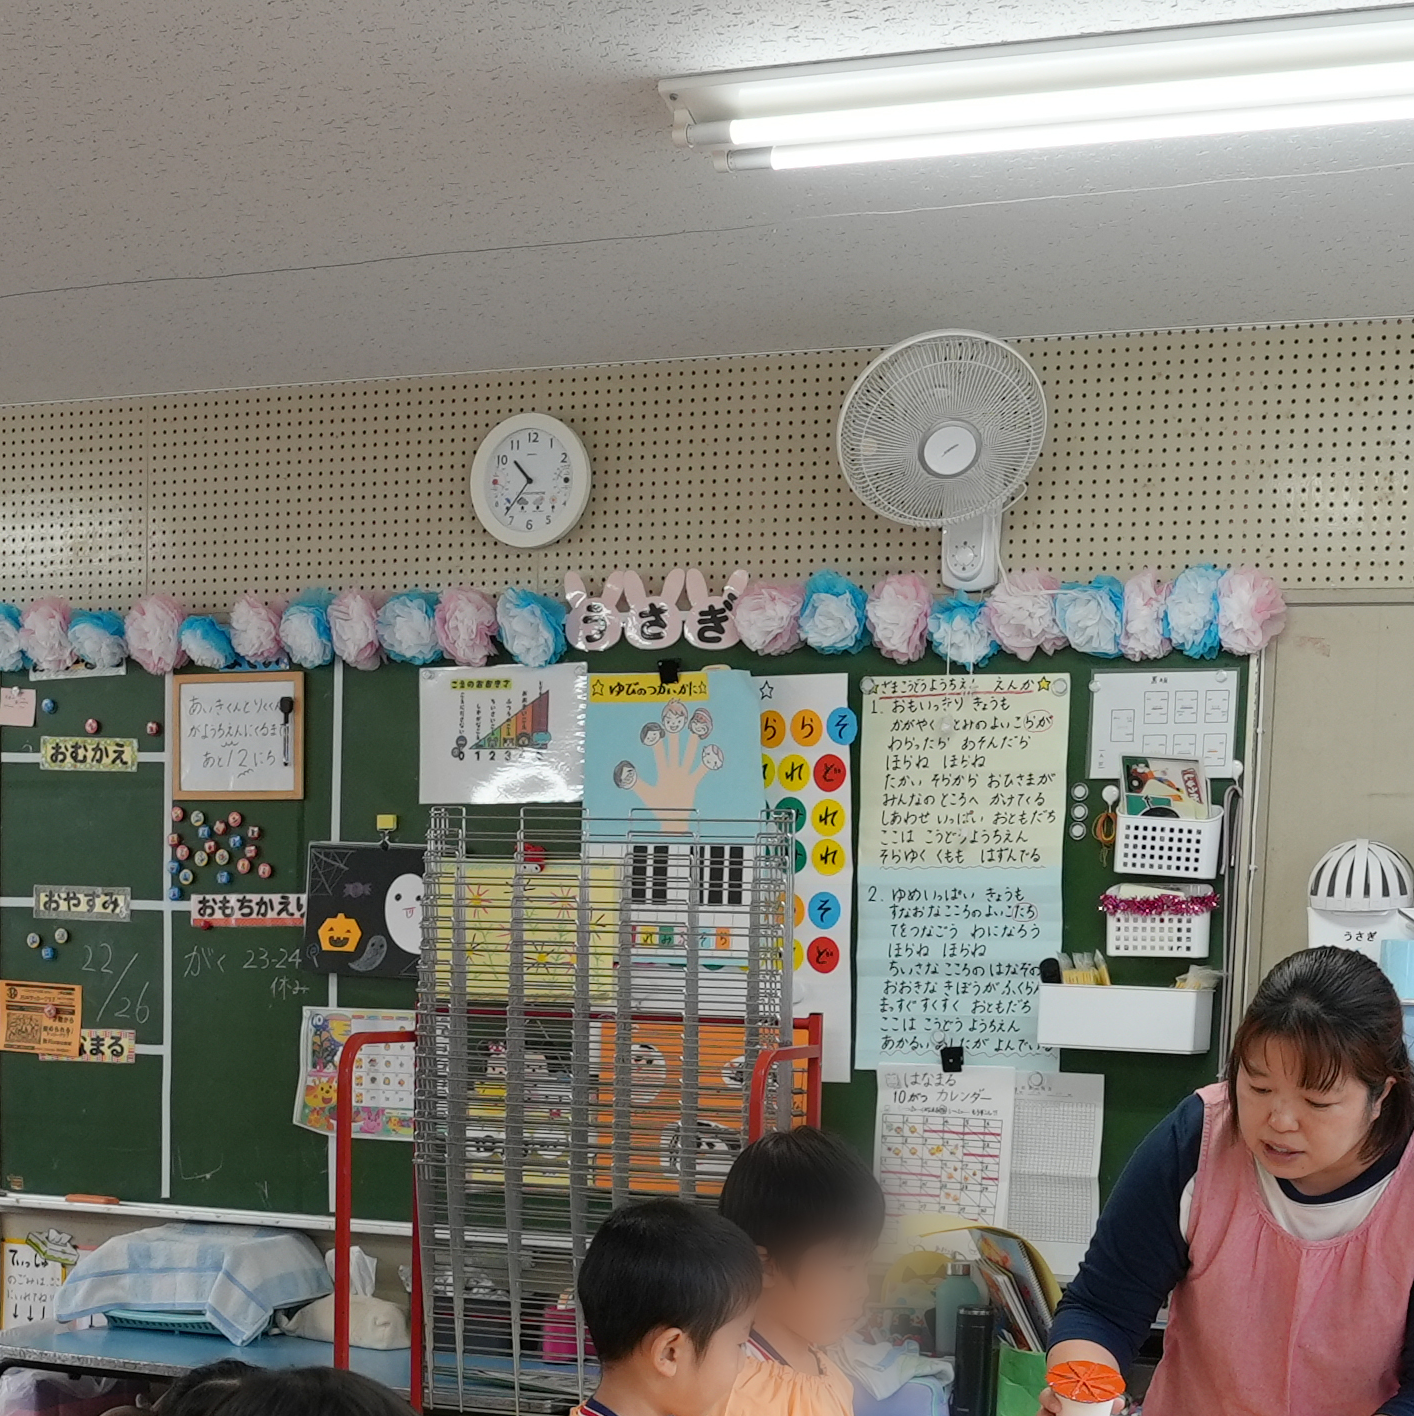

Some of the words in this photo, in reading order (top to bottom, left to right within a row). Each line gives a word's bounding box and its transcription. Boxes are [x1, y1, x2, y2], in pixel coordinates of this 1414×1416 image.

[510, 440, 520, 450] 11
[528, 432, 539, 443] 12
[497, 455, 508, 466] 10
[560, 452, 569, 463] 2
[508, 516, 515, 525] 7
[526, 520, 533, 530] 6
[545, 515, 552, 525] 5
[583, 593, 738, 643] うさぎ
[994, 677, 1035, 691] えんか
[891, 697, 964, 714] おもいっきり
[973, 697, 1010, 711] きょうも
[802, 718, 815, 741] ら
[835, 715, 850, 738] そ
[890, 719, 935, 732] かがやく
[888, 736, 950, 750] わらったら
[962, 736, 1031, 750] あそんだら
[50, 742, 129, 766] おむかえ
[475, 751, 480, 760] 1
[489, 751, 496, 760] 2
[886, 755, 929, 770] ほらね
[943, 755, 986, 769] ほらね
[785, 764, 803, 783] れ
[885, 774, 922, 790] たかい
[931, 774, 978, 787] そらから
[988, 773, 1055, 788] おひさまが
[882, 793, 935, 806] みんなの
[941, 793, 979, 807] ところへ
[989, 793, 1045, 806] かけてくる
[818, 807, 838, 826] れ
[881, 811, 930, 825] しあわせ
[937, 810, 983, 825] いっぱい
[993, 811, 1056, 825] おともだち
[880, 830, 915, 845] ここは
[818, 847, 838, 867] れ
[880, 849, 926, 864] そらゆく
[936, 850, 965, 864] くもも
[980, 849, 1041, 863] はずんでる
[43, 890, 120, 914] おやすみ
[892, 888, 975, 902] ゆめいっぱい
[985, 887, 1025, 902] きょうも
[817, 900, 831, 922] そ
[890, 924, 958, 938] てをつなごう
[971, 924, 1041, 939] わになろう
[1343, 930, 1377, 942] うさぎ
[889, 943, 930, 958] ほらね
[943, 943, 987, 958] ほらね
[889, 961, 939, 976] ちいさな
[945, 963, 985, 976] こころの
[884, 980, 938, 995] おおきな
[943, 980, 998, 997] きぼうが
[921, 998, 960, 1013] すくすく
[971, 999, 1032, 1014] おともだち
[880, 1017, 916, 1032] ここは
[881, 1035, 930, 1050] あかるい
[904, 1072, 957, 1087] はなまる
[936, 1088, 992, 1104] カレンダー
